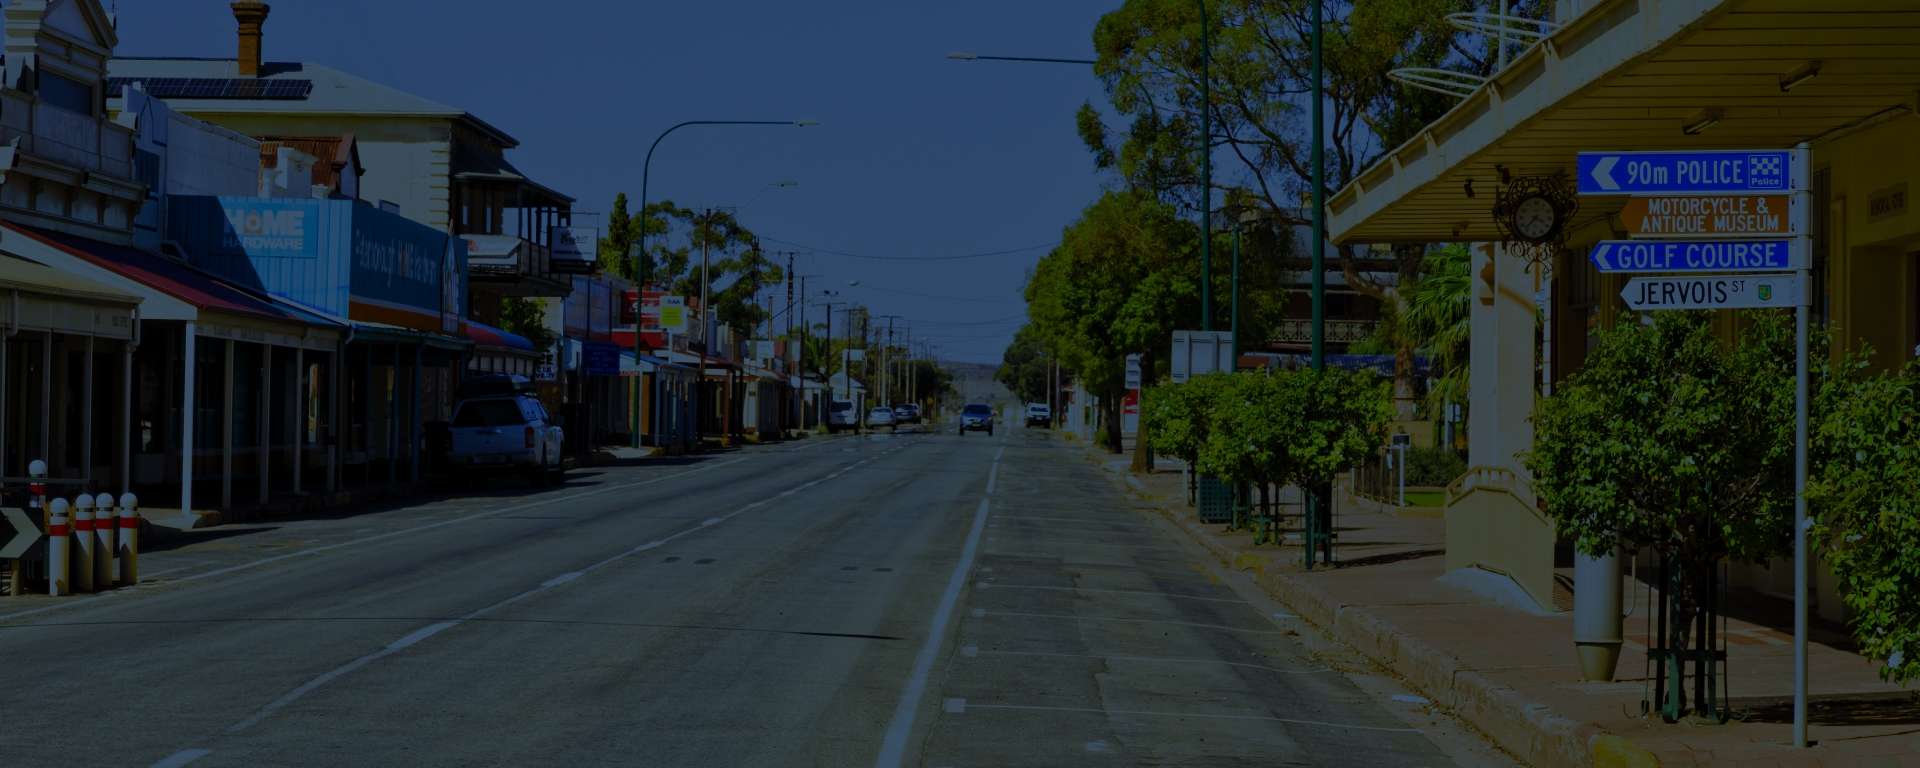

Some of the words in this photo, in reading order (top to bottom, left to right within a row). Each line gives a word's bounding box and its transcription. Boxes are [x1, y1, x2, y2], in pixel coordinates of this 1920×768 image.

[1627, 160, 1668, 184] 90m
[1677, 159, 1743, 184] POLICE
[1751, 178, 1779, 186] Police
[1649, 198, 1749, 215] MOTORCYCLE
[1757, 197, 1768, 215] &
[222, 208, 304, 235] HOME
[1641, 216, 1707, 232] ANTIQUE
[1714, 216, 1779, 232] MUSEUM
[224, 238, 304, 249] HARDWARE
[1617, 244, 1677, 267] GOLF
[1686, 243, 1777, 267] COURSE
[1634, 282, 1727, 305] JERVOIS
[1732, 280, 1745, 292] ST
